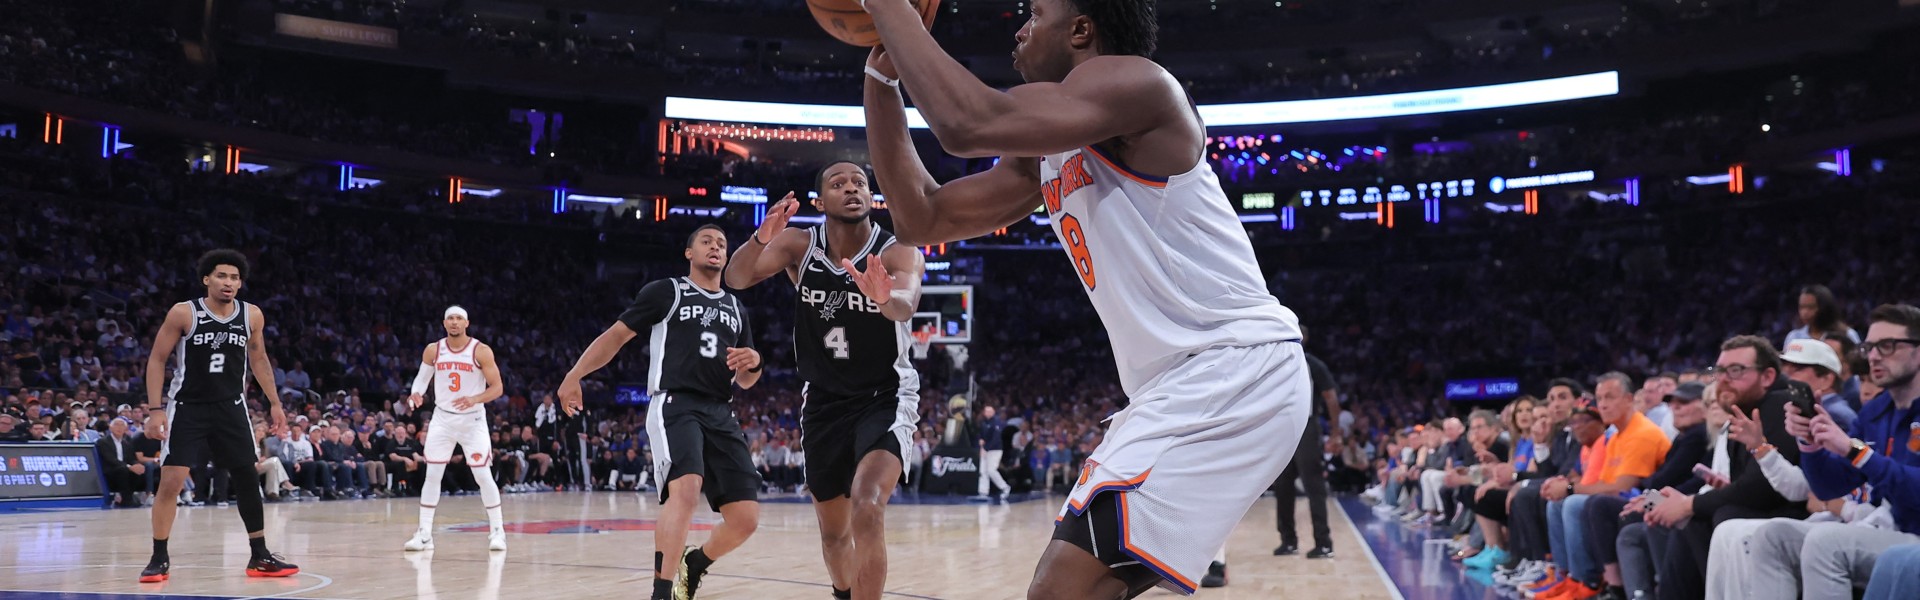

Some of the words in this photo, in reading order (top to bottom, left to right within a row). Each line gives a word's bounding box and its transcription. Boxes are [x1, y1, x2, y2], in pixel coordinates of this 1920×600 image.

[1060, 152, 1094, 198] ORK
[1059, 212, 1096, 292] 8
[802, 286, 881, 321] SPURS
[680, 305, 738, 333] SPURS
[193, 332, 247, 350] SPURS
[699, 331, 718, 358] 3
[823, 326, 849, 359] 4
[209, 353, 225, 373] 2
[437, 362, 453, 370] NEW
[454, 362, 473, 372] YORK
[448, 372, 461, 392] 3
[21, 456, 89, 472] HURRICANES
[941, 456, 977, 477] Finals
